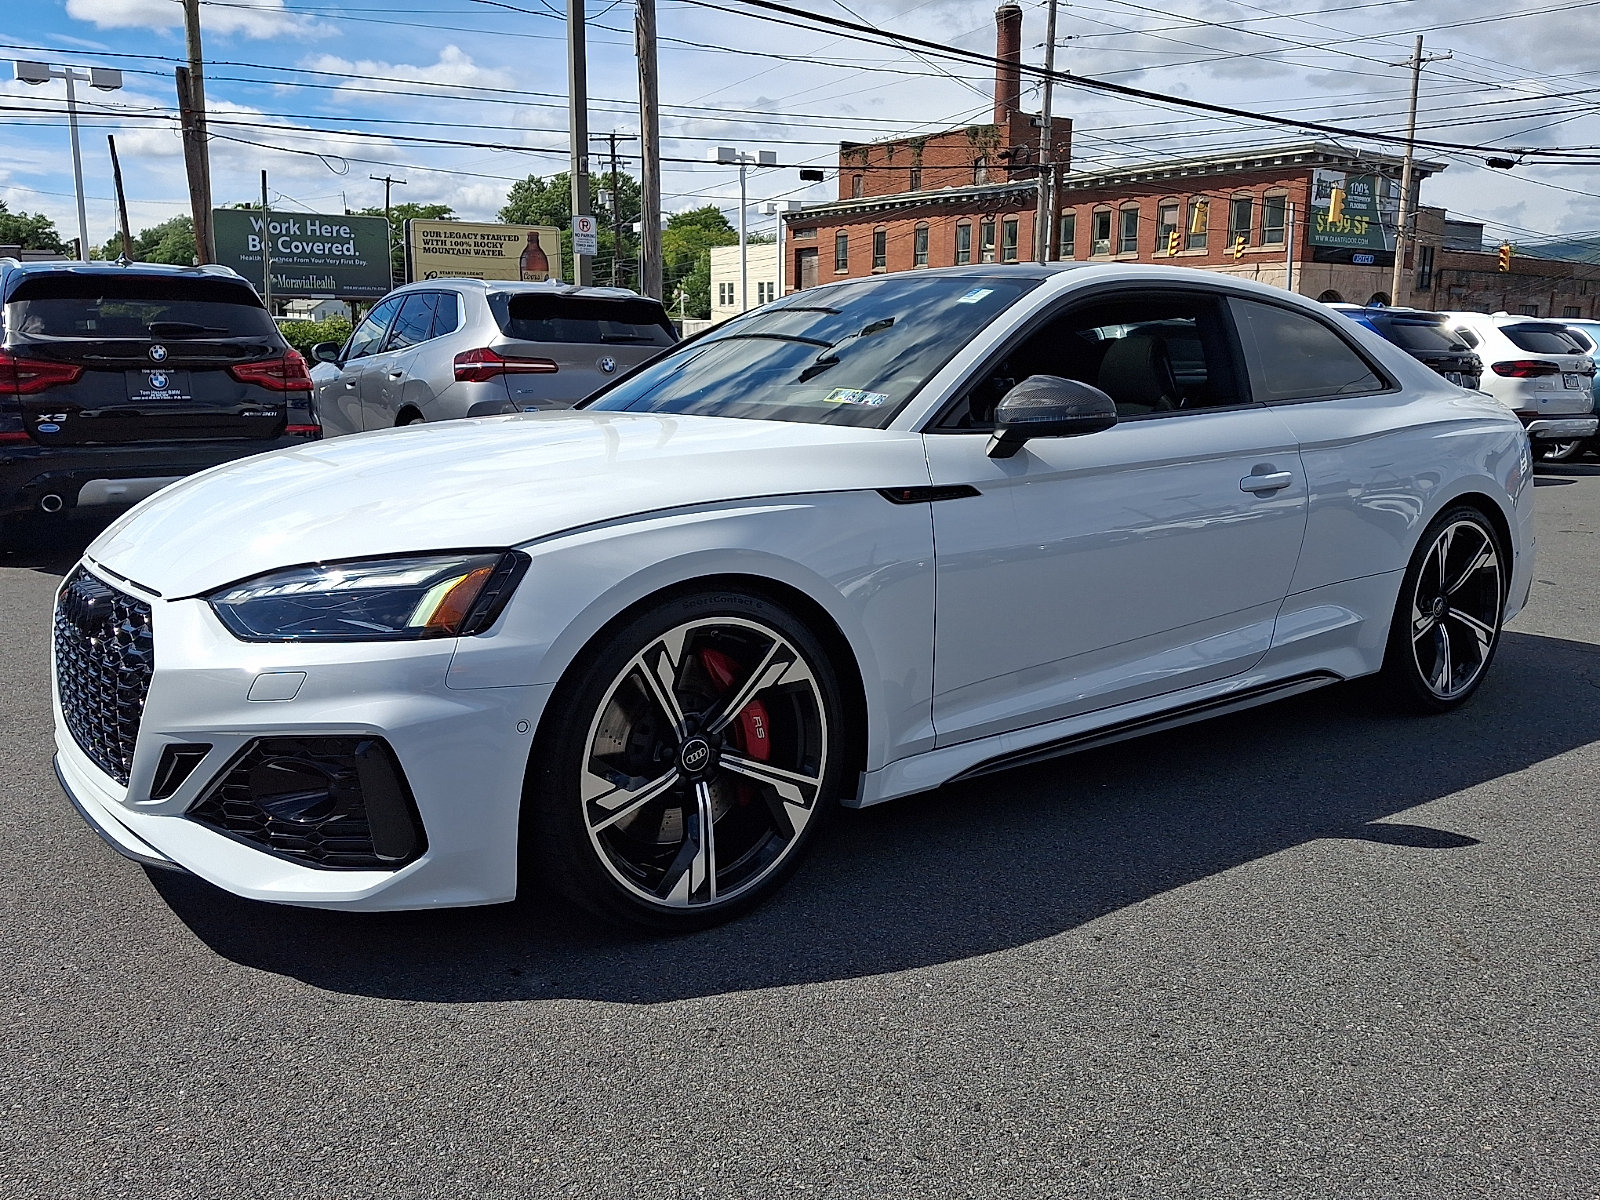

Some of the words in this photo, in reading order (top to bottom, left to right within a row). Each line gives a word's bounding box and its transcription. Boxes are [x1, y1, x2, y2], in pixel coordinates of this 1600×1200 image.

[1350, 182, 1370, 195] 100%
[249, 216, 301, 236] Work
[306, 219, 355, 238] Here.
[1354, 215, 1370, 235] SF
[422, 230, 443, 238] OUR
[443, 231, 479, 240] LEGACY
[480, 233, 520, 242] STARTED
[277, 236, 360, 256] Covered.
[473, 241, 504, 249] ROCKY
[422, 247, 471, 255] MOUNTAIN
[473, 248, 506, 257] WATER.
[326, 257, 340, 266] Very
[277, 274, 336, 290] MoraviaHealth
[34, 413, 68, 422] X3
[753, 716, 766, 739] RS
